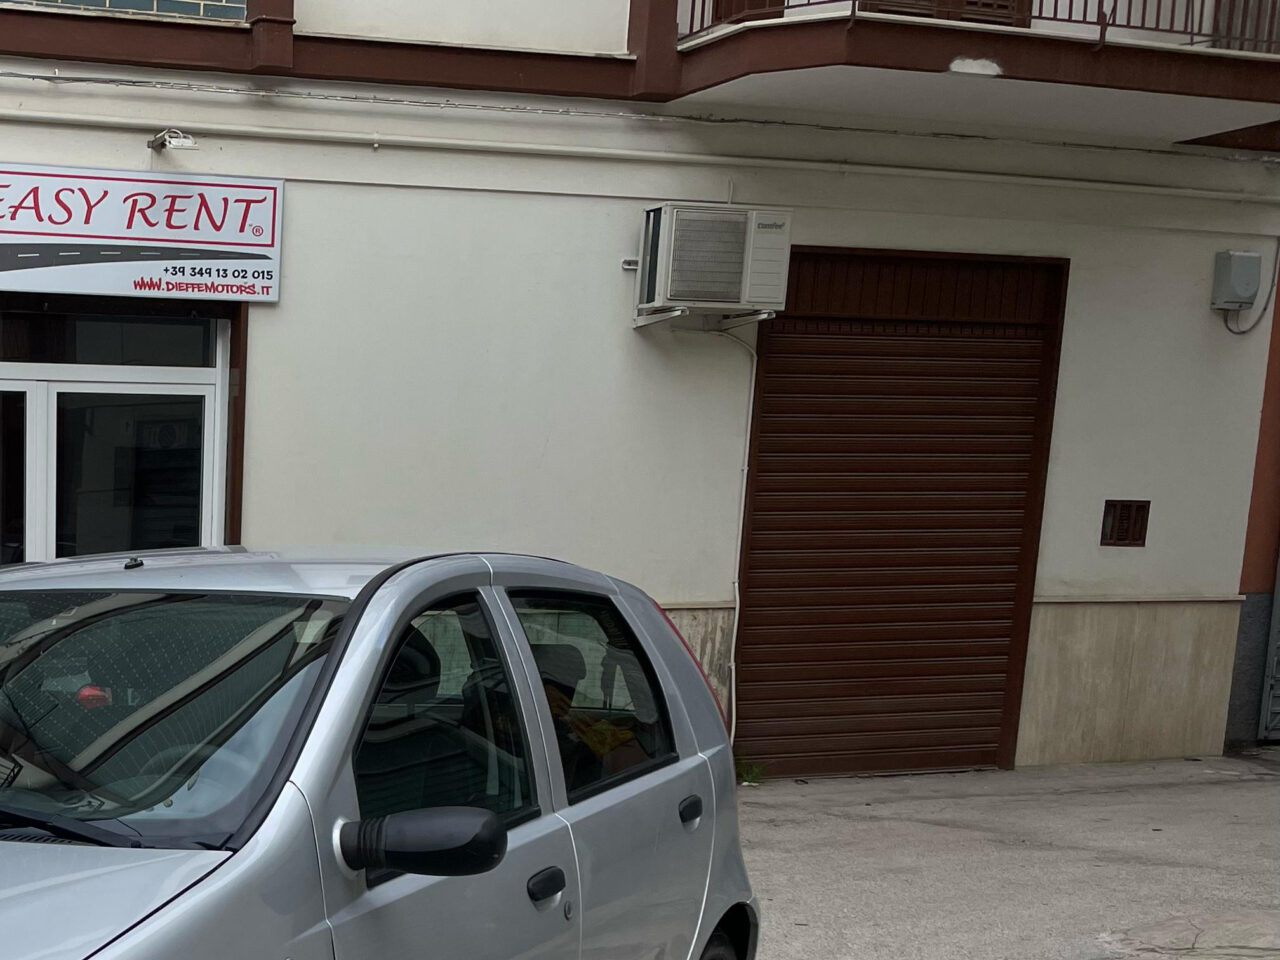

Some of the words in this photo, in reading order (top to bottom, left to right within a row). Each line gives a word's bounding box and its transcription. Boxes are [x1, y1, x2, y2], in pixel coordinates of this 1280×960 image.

[163, 266, 186, 276] +39
[189, 267, 212, 278] 349
[215, 268, 229, 278] 13
[232, 269, 248, 279] 02
[252, 270, 274, 280] 015
